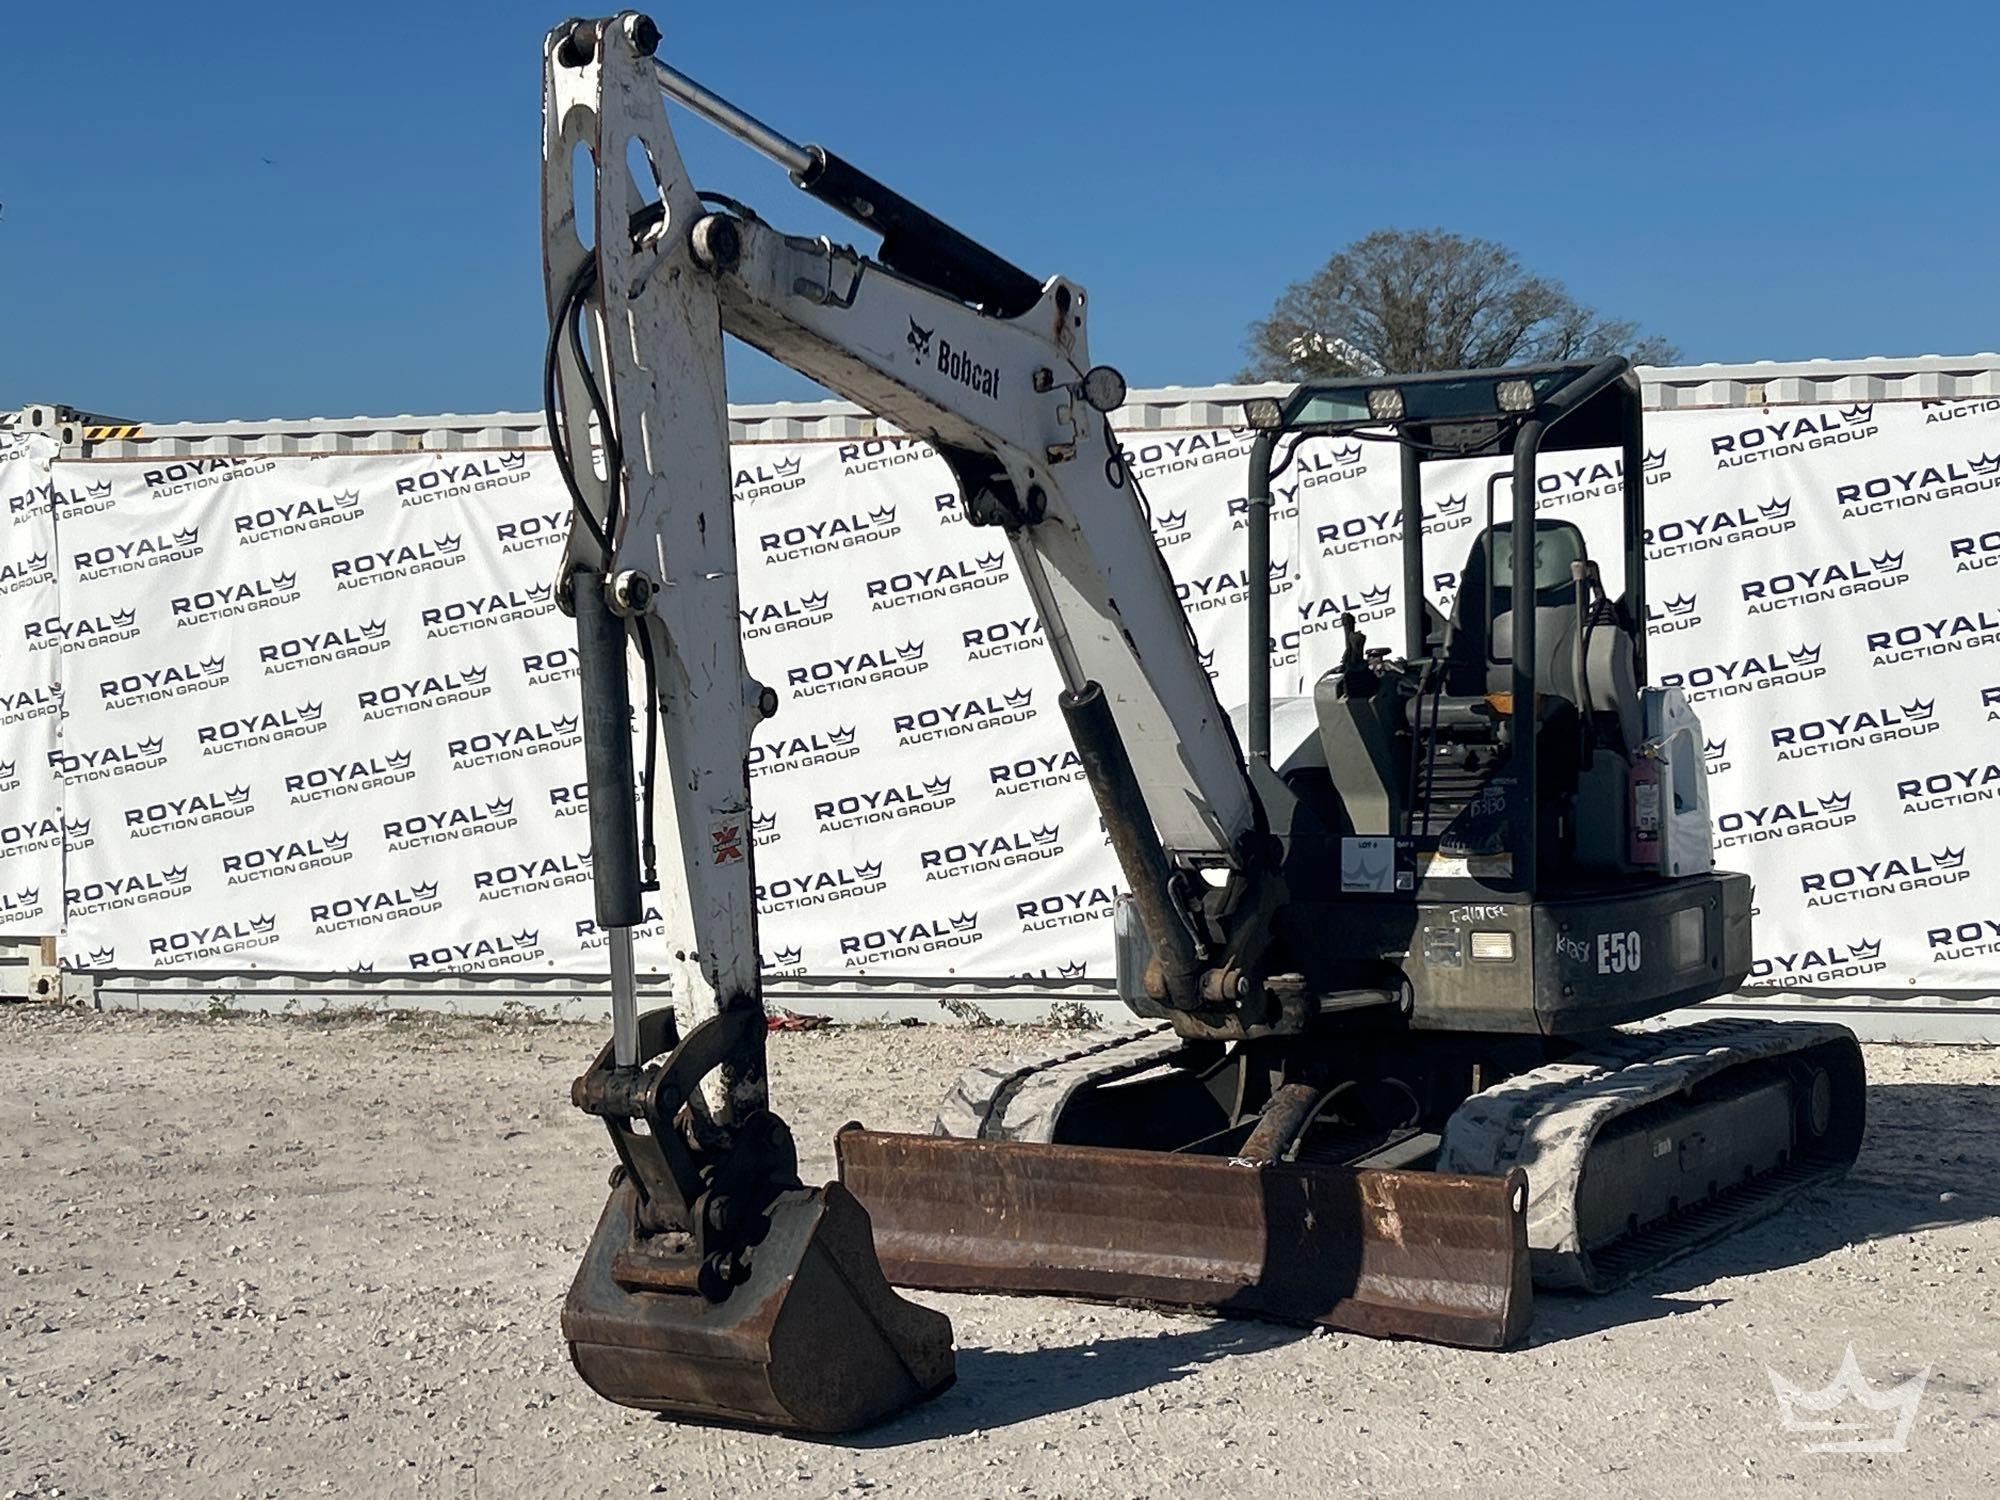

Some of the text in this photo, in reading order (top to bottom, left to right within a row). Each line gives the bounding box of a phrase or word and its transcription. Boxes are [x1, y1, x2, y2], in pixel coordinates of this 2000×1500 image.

[938, 340, 1000, 400] Bobcat
[1925, 400, 2000, 424] AUCTIO
[1711, 414, 1840, 455] ROYAL
[1718, 426, 1878, 470] AUCTION GROUP
[153, 462, 276, 499] AUCTION GROUP
[396, 460, 500, 495] ROYAL
[845, 451, 918, 476] AUCTION
[1303, 466, 1367, 488] GROUP
[402, 472, 530, 508] AUCTION GROUP
[748, 478, 805, 498] GROUP
[1836, 464, 1968, 504] ROYAL
[63, 500, 116, 519] GROUP
[234, 498, 334, 533] ROYAL
[1843, 492, 1932, 519] AUCTION
[240, 509, 364, 546] AUCTION GROUP
[760, 515, 869, 552] ROYAL
[1323, 516, 1473, 558] AUCTION ROUP
[1644, 521, 1796, 561] UCTION GROUP
[74, 536, 172, 570] ROYAL
[332, 543, 435, 578] ROYAL
[766, 527, 901, 565] AUCTION GROUP
[80, 547, 203, 582] AUCTION GROUP
[338, 555, 465, 591] AUCTION GROUP
[866, 561, 976, 598] ROYAL
[1741, 561, 1871, 601] ROYAL
[171, 580, 272, 615] ROYAL
[177, 592, 300, 628] AUCTION GROUP
[422, 592, 526, 626] ROYAL
[872, 574, 1009, 612] AUCTION GROUP
[1748, 574, 1909, 615] AUCTION GROUP
[88, 628, 140, 647] GROUP
[427, 604, 556, 639] AUCTION GROUP
[775, 613, 833, 632] GROUP
[1647, 616, 1702, 636] ROUP
[1867, 612, 1999, 652] ROYAL
[259, 628, 360, 662] ROYAL
[265, 640, 390, 675] AUCTION GROUP
[968, 637, 1043, 661] AUCTION
[1873, 640, 1962, 667] AUCTION
[100, 664, 200, 698] ROYAL
[787, 650, 897, 686] ROYAL
[793, 662, 928, 699] AUCTION GROUP
[1757, 668, 1826, 689] GROUP
[106, 676, 229, 710] AUCTION GROUP
[358, 674, 461, 709] ROYAL
[364, 687, 491, 722] AUCTION GROUP
[198, 710, 298, 744] ROYAL
[893, 697, 1004, 733] ROYAL
[899, 710, 1037, 747] AUCTION GROUP
[1771, 709, 1901, 747] ROYAL
[203, 722, 327, 756] AUCTION GROUP
[448, 724, 552, 758] ROYAL
[454, 736, 582, 770] AUCTION GROUP
[749, 734, 829, 764] OYAL
[1777, 722, 1939, 762] AUCTION GROUP
[114, 757, 167, 775] GROUP
[802, 748, 860, 766] GROUP
[989, 751, 1082, 784] ROYA
[285, 758, 386, 792] ROYAL
[290, 771, 415, 805] AUCTION GROUP
[996, 774, 1070, 797] AUCTION
[1897, 765, 2000, 800] ROYA
[124, 793, 225, 826] ROYAL
[814, 785, 924, 820] ROYAL
[820, 798, 956, 833] AUCTION GROUP
[1718, 801, 1819, 832] OYAL
[1904, 789, 1993, 814] AUCTION
[130, 806, 254, 839] AUCTION GROUP
[384, 806, 487, 839] ROYAL
[389, 818, 517, 852] AUCTION GROUP
[1787, 815, 1856, 835] GROUP
[223, 840, 324, 873] ROYAL
[921, 833, 1031, 869] ROYAL
[926, 846, 1064, 882] AUCTION GROUP
[228, 852, 352, 886] AUCTION GROUP
[474, 856, 578, 889] ROYAL
[1800, 856, 1932, 893] ROYAL
[64, 873, 163, 906] ROYAL
[68, 886, 191, 919] AUCTION GROUP
[479, 871, 594, 902] AUCTION GROU
[828, 882, 886, 901] GROUP
[1807, 871, 1970, 908] AUCTION GROUP
[310, 890, 412, 922] ROYAL
[316, 902, 442, 934] AUCTION GROUP
[1022, 910, 1098, 933] AUCTION
[149, 922, 250, 954] ROYAL
[154, 935, 279, 967] AUCTION GROUP
[409, 938, 513, 969] ROYAL
[840, 920, 950, 954] ROYAL
[845, 933, 982, 968] AUCTION GROUP
[1597, 931, 1641, 974] E50
[488, 950, 544, 967] GROUP
[1817, 962, 1886, 982] GROUP
